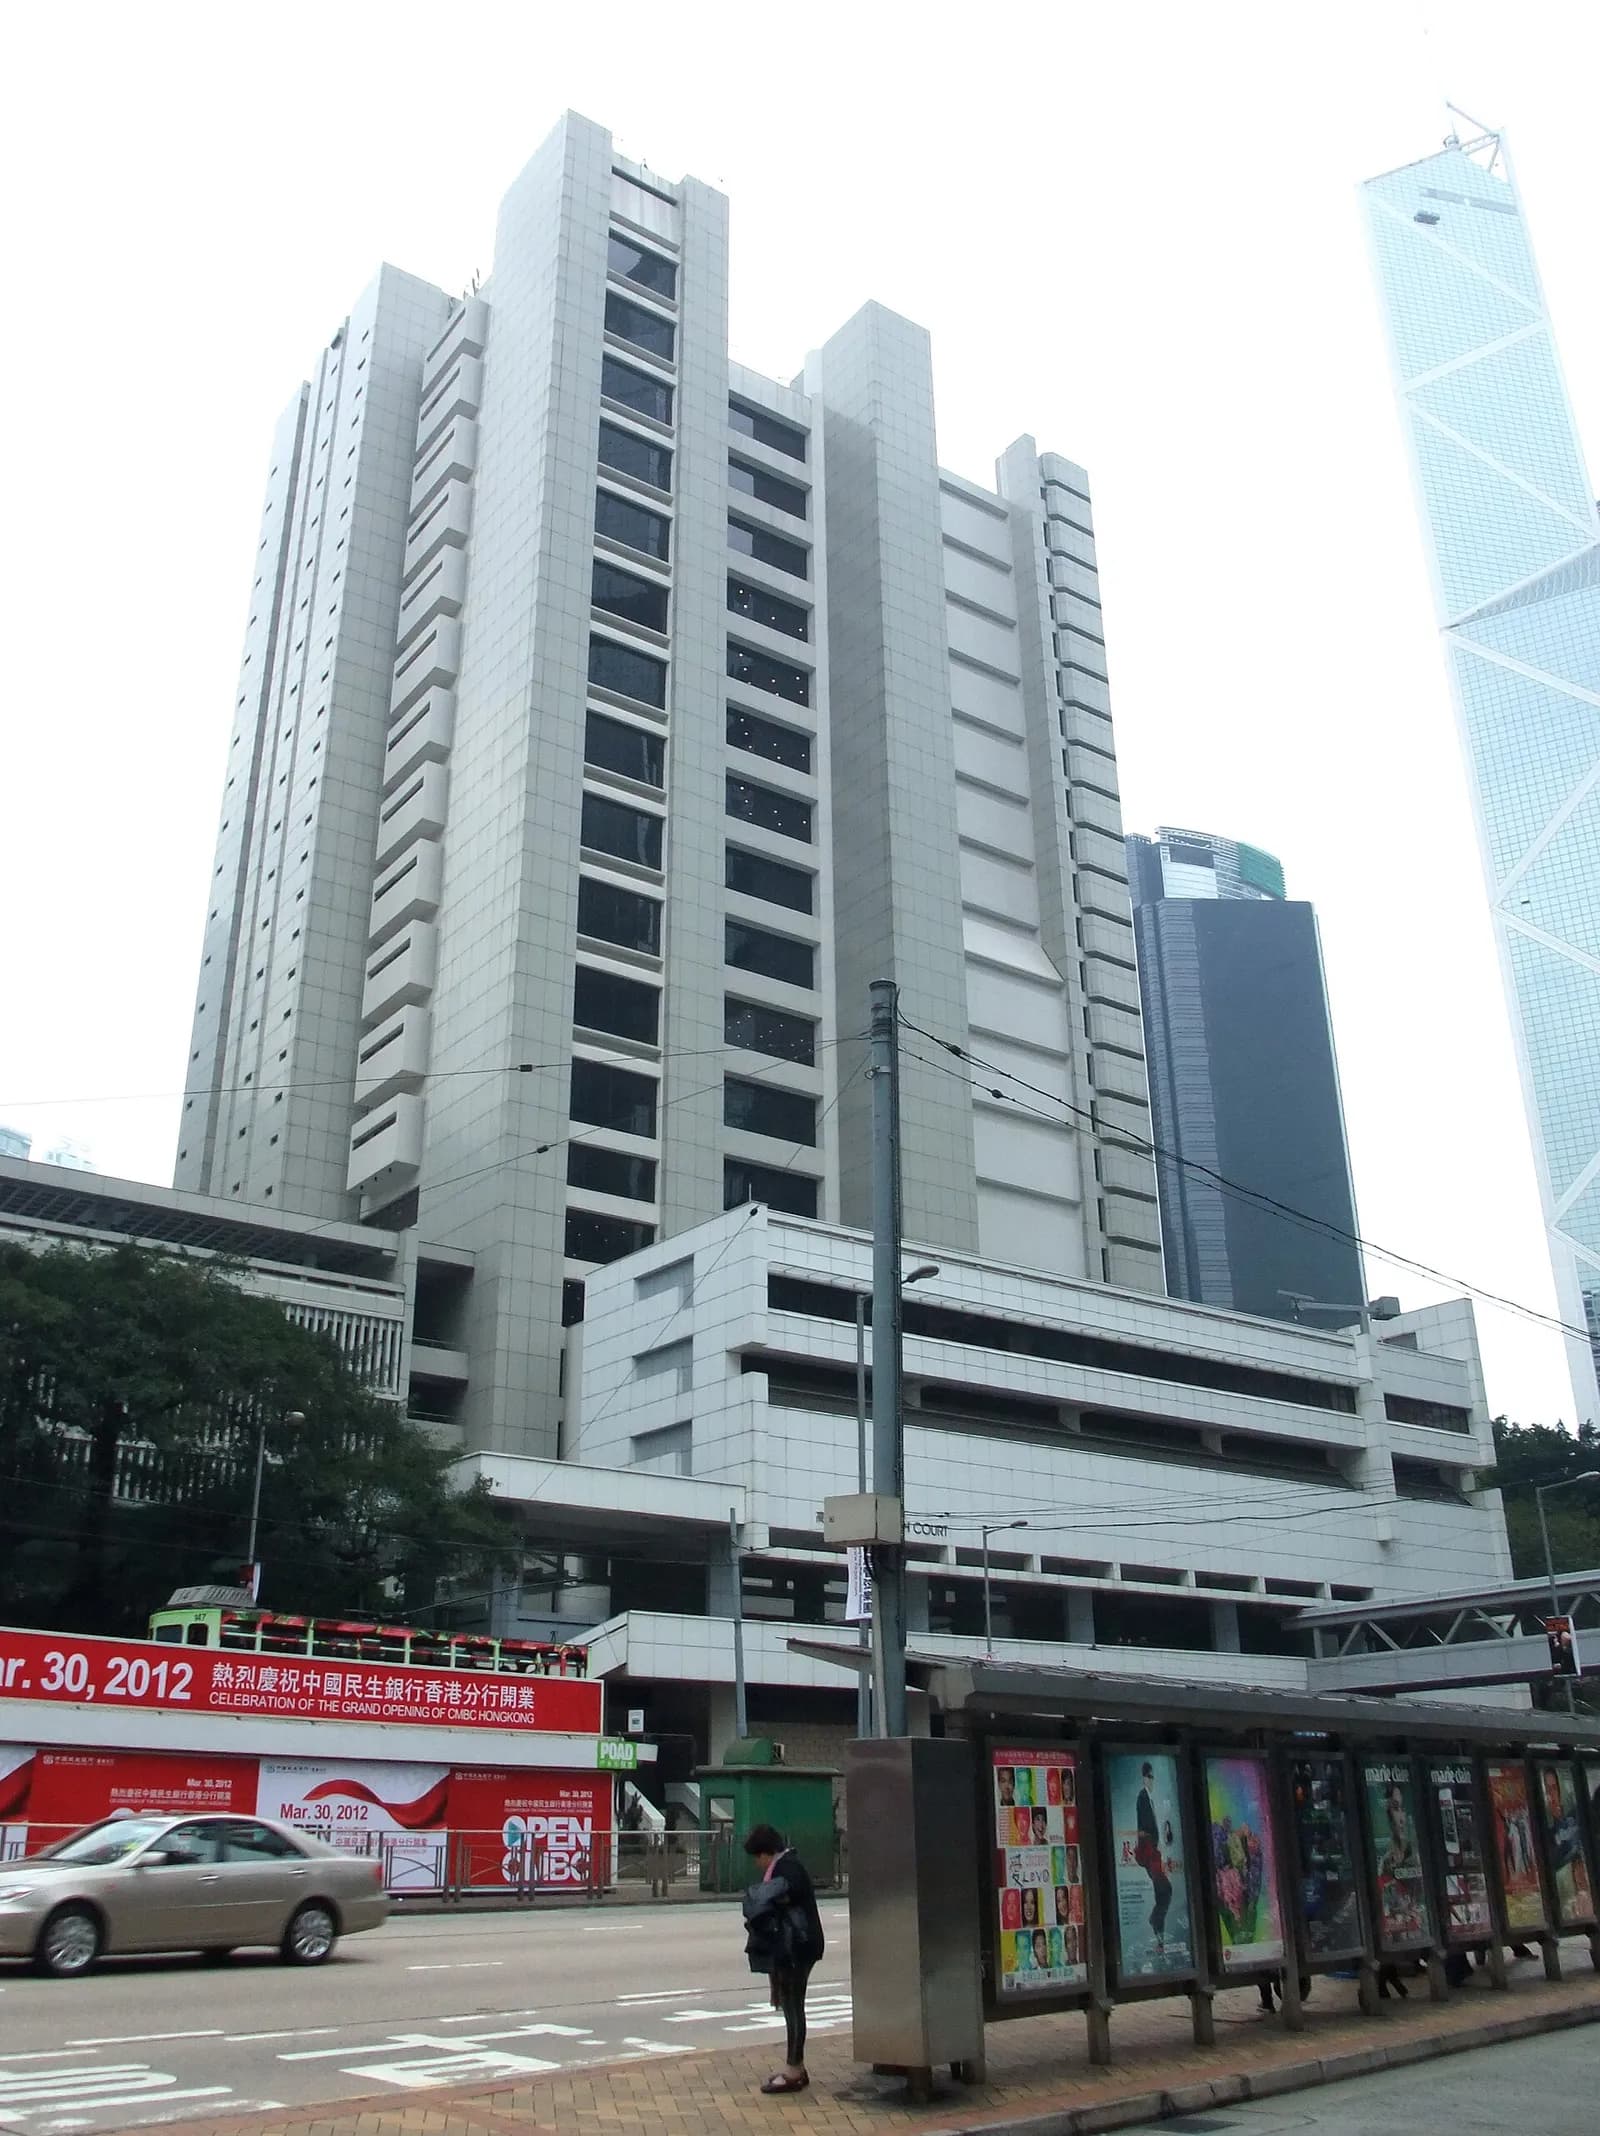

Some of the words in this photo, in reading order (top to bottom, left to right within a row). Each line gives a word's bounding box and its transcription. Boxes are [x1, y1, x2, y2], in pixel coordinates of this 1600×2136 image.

[912, 1522, 948, 1537] COURT
[0, 1658, 31, 1688] r.
[41, 1651, 95, 1700] 30,
[103, 1656, 193, 1700] 2012
[211, 1662, 535, 1709] 熱烈慶祝中國民生銀行香港分行開業
[209, 1692, 295, 1709] CELEBRATION
[298, 1699, 317, 1710] OF
[318, 1700, 339, 1712] THE
[341, 1701, 381, 1715] GRAND
[383, 1704, 430, 1718] OPENING
[431, 1707, 446, 1719] OF
[448, 1708, 477, 1720] CMBC
[478, 1710, 535, 1723] HONGKONG
[599, 1742, 634, 1761] POAD
[280, 1803, 311, 1820] Mar.
[314, 1804, 334, 1822] 30,
[336, 1804, 368, 1820] 2012
[502, 1815, 592, 1850] OPEN
